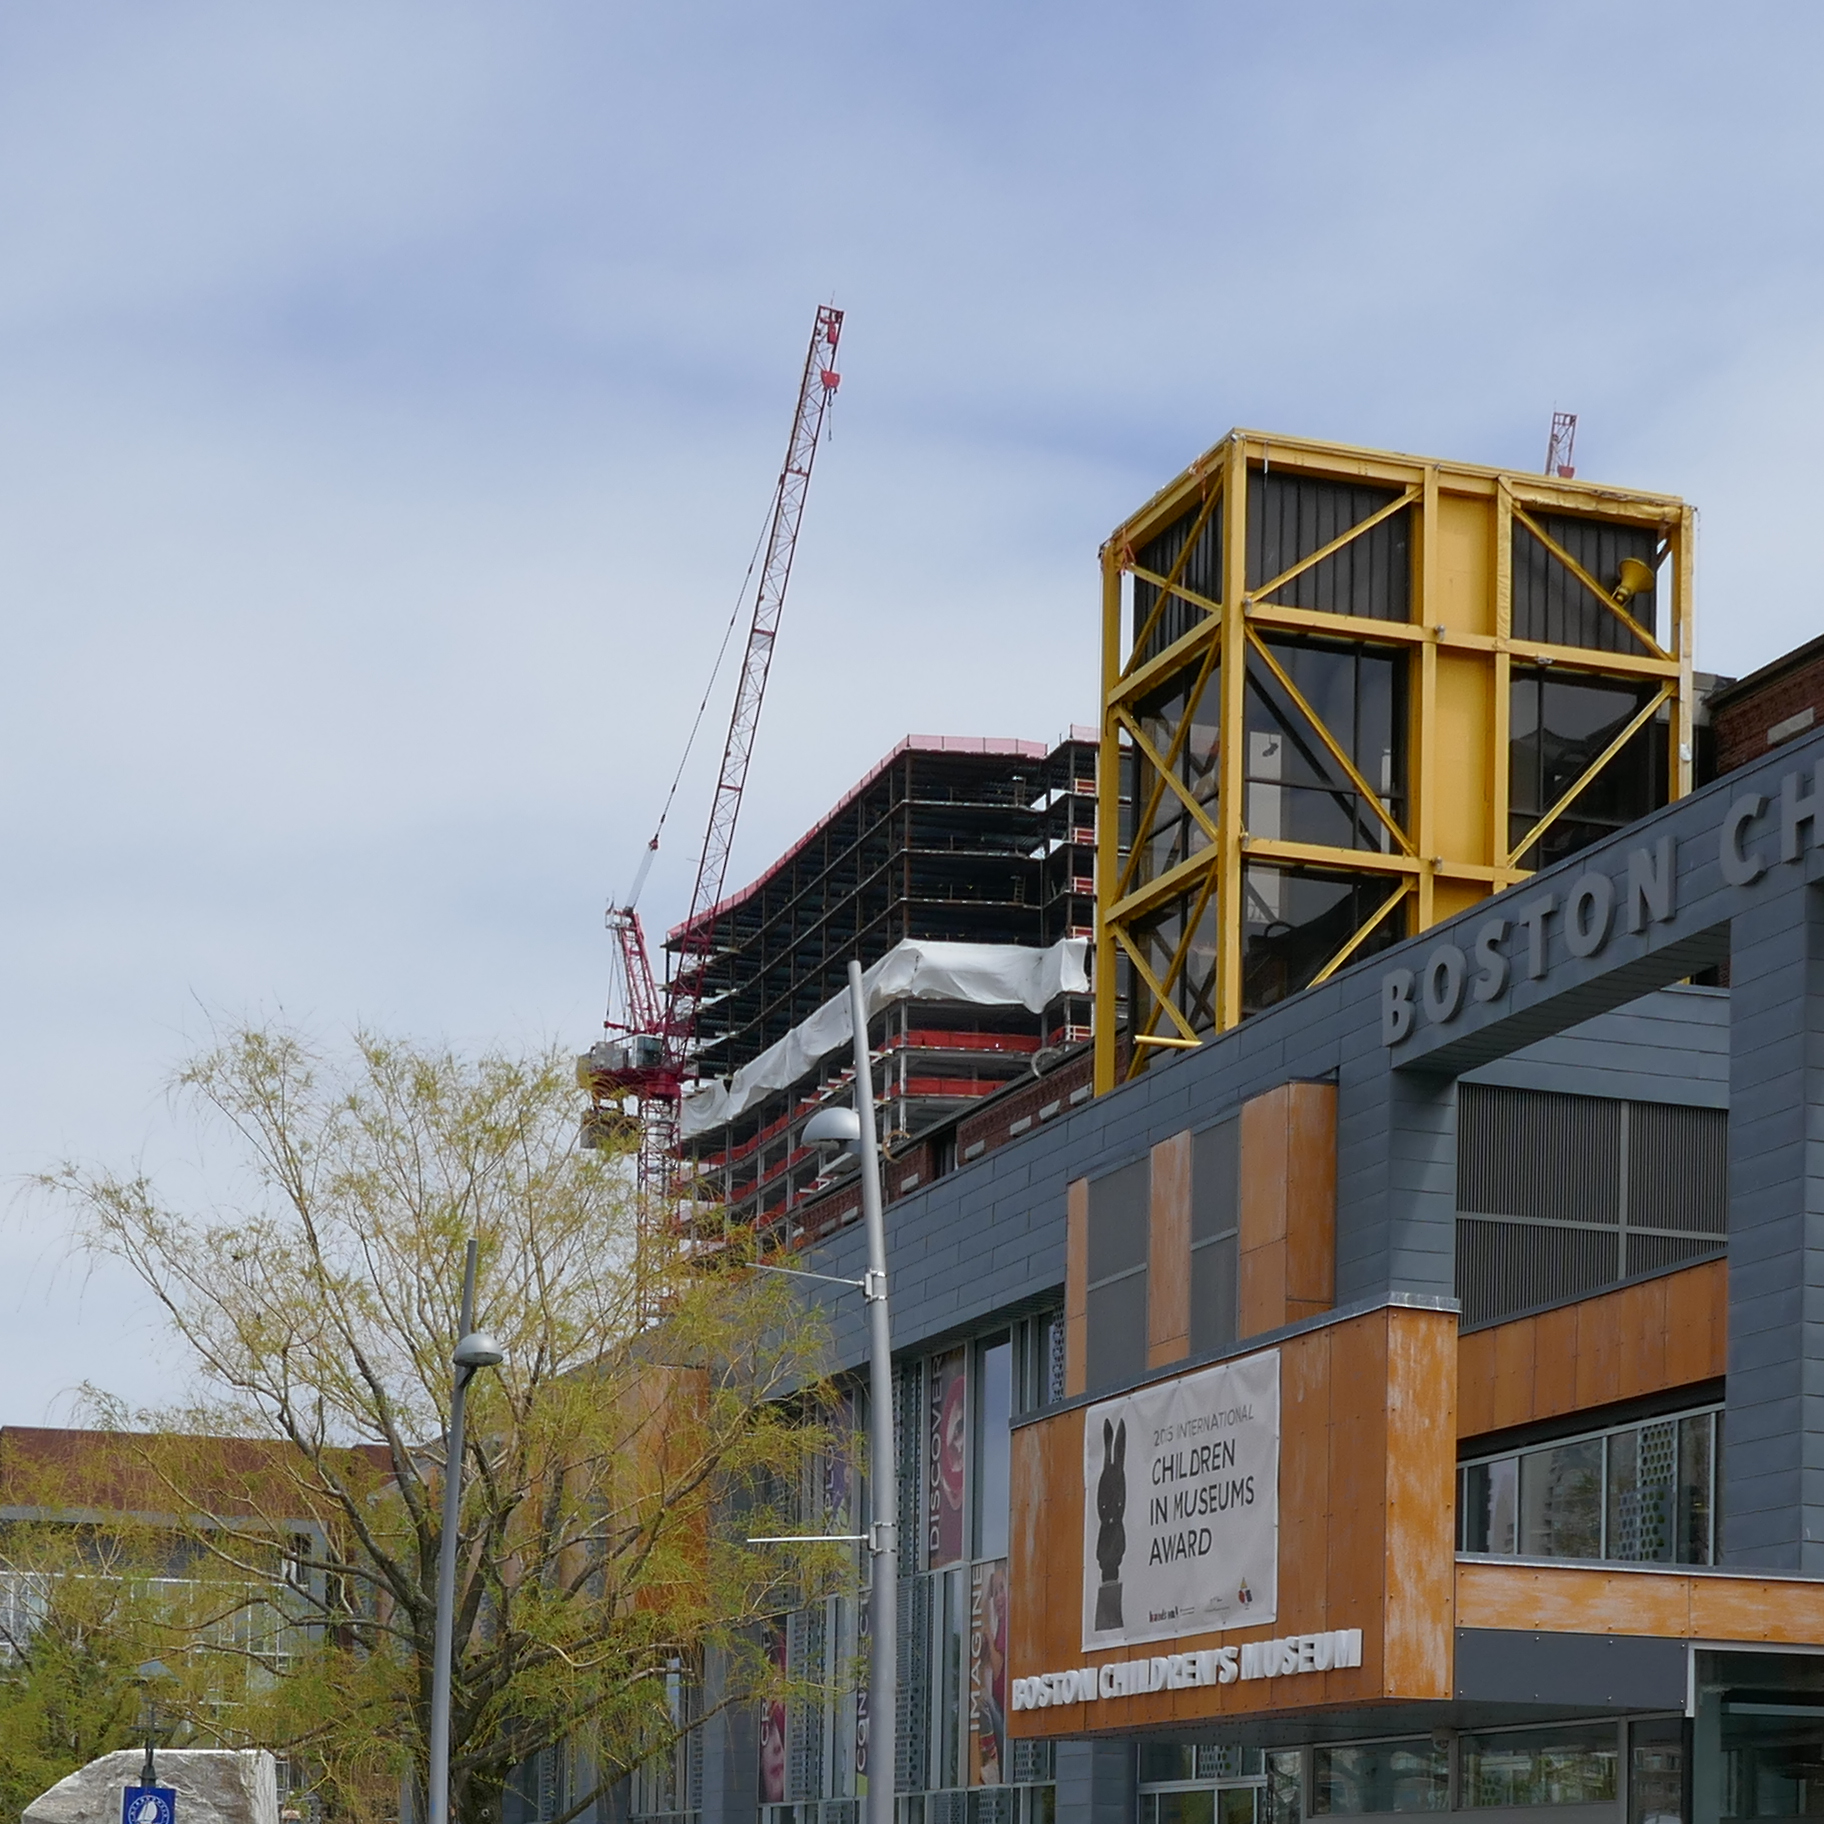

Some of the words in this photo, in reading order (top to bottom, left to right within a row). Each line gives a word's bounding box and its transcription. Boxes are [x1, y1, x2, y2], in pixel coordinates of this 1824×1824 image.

[1382, 834, 1677, 1047] BOSTON
[929, 1355, 944, 1552] DISCOVER
[1176, 1404, 1255, 1439] INTERNATIONAL
[1152, 1439, 1236, 1486] CHILDREN
[1150, 1495, 1169, 1527] IN
[1172, 1476, 1256, 1520] MUSEUMS
[1149, 1527, 1213, 1567] AWARD
[970, 1565, 983, 1731] IMAGINE
[1012, 1667, 1099, 1712] BOSTON
[1099, 1646, 1239, 1700] CHILDREN'S
[1241, 1629, 1363, 1681] MUSEUM
